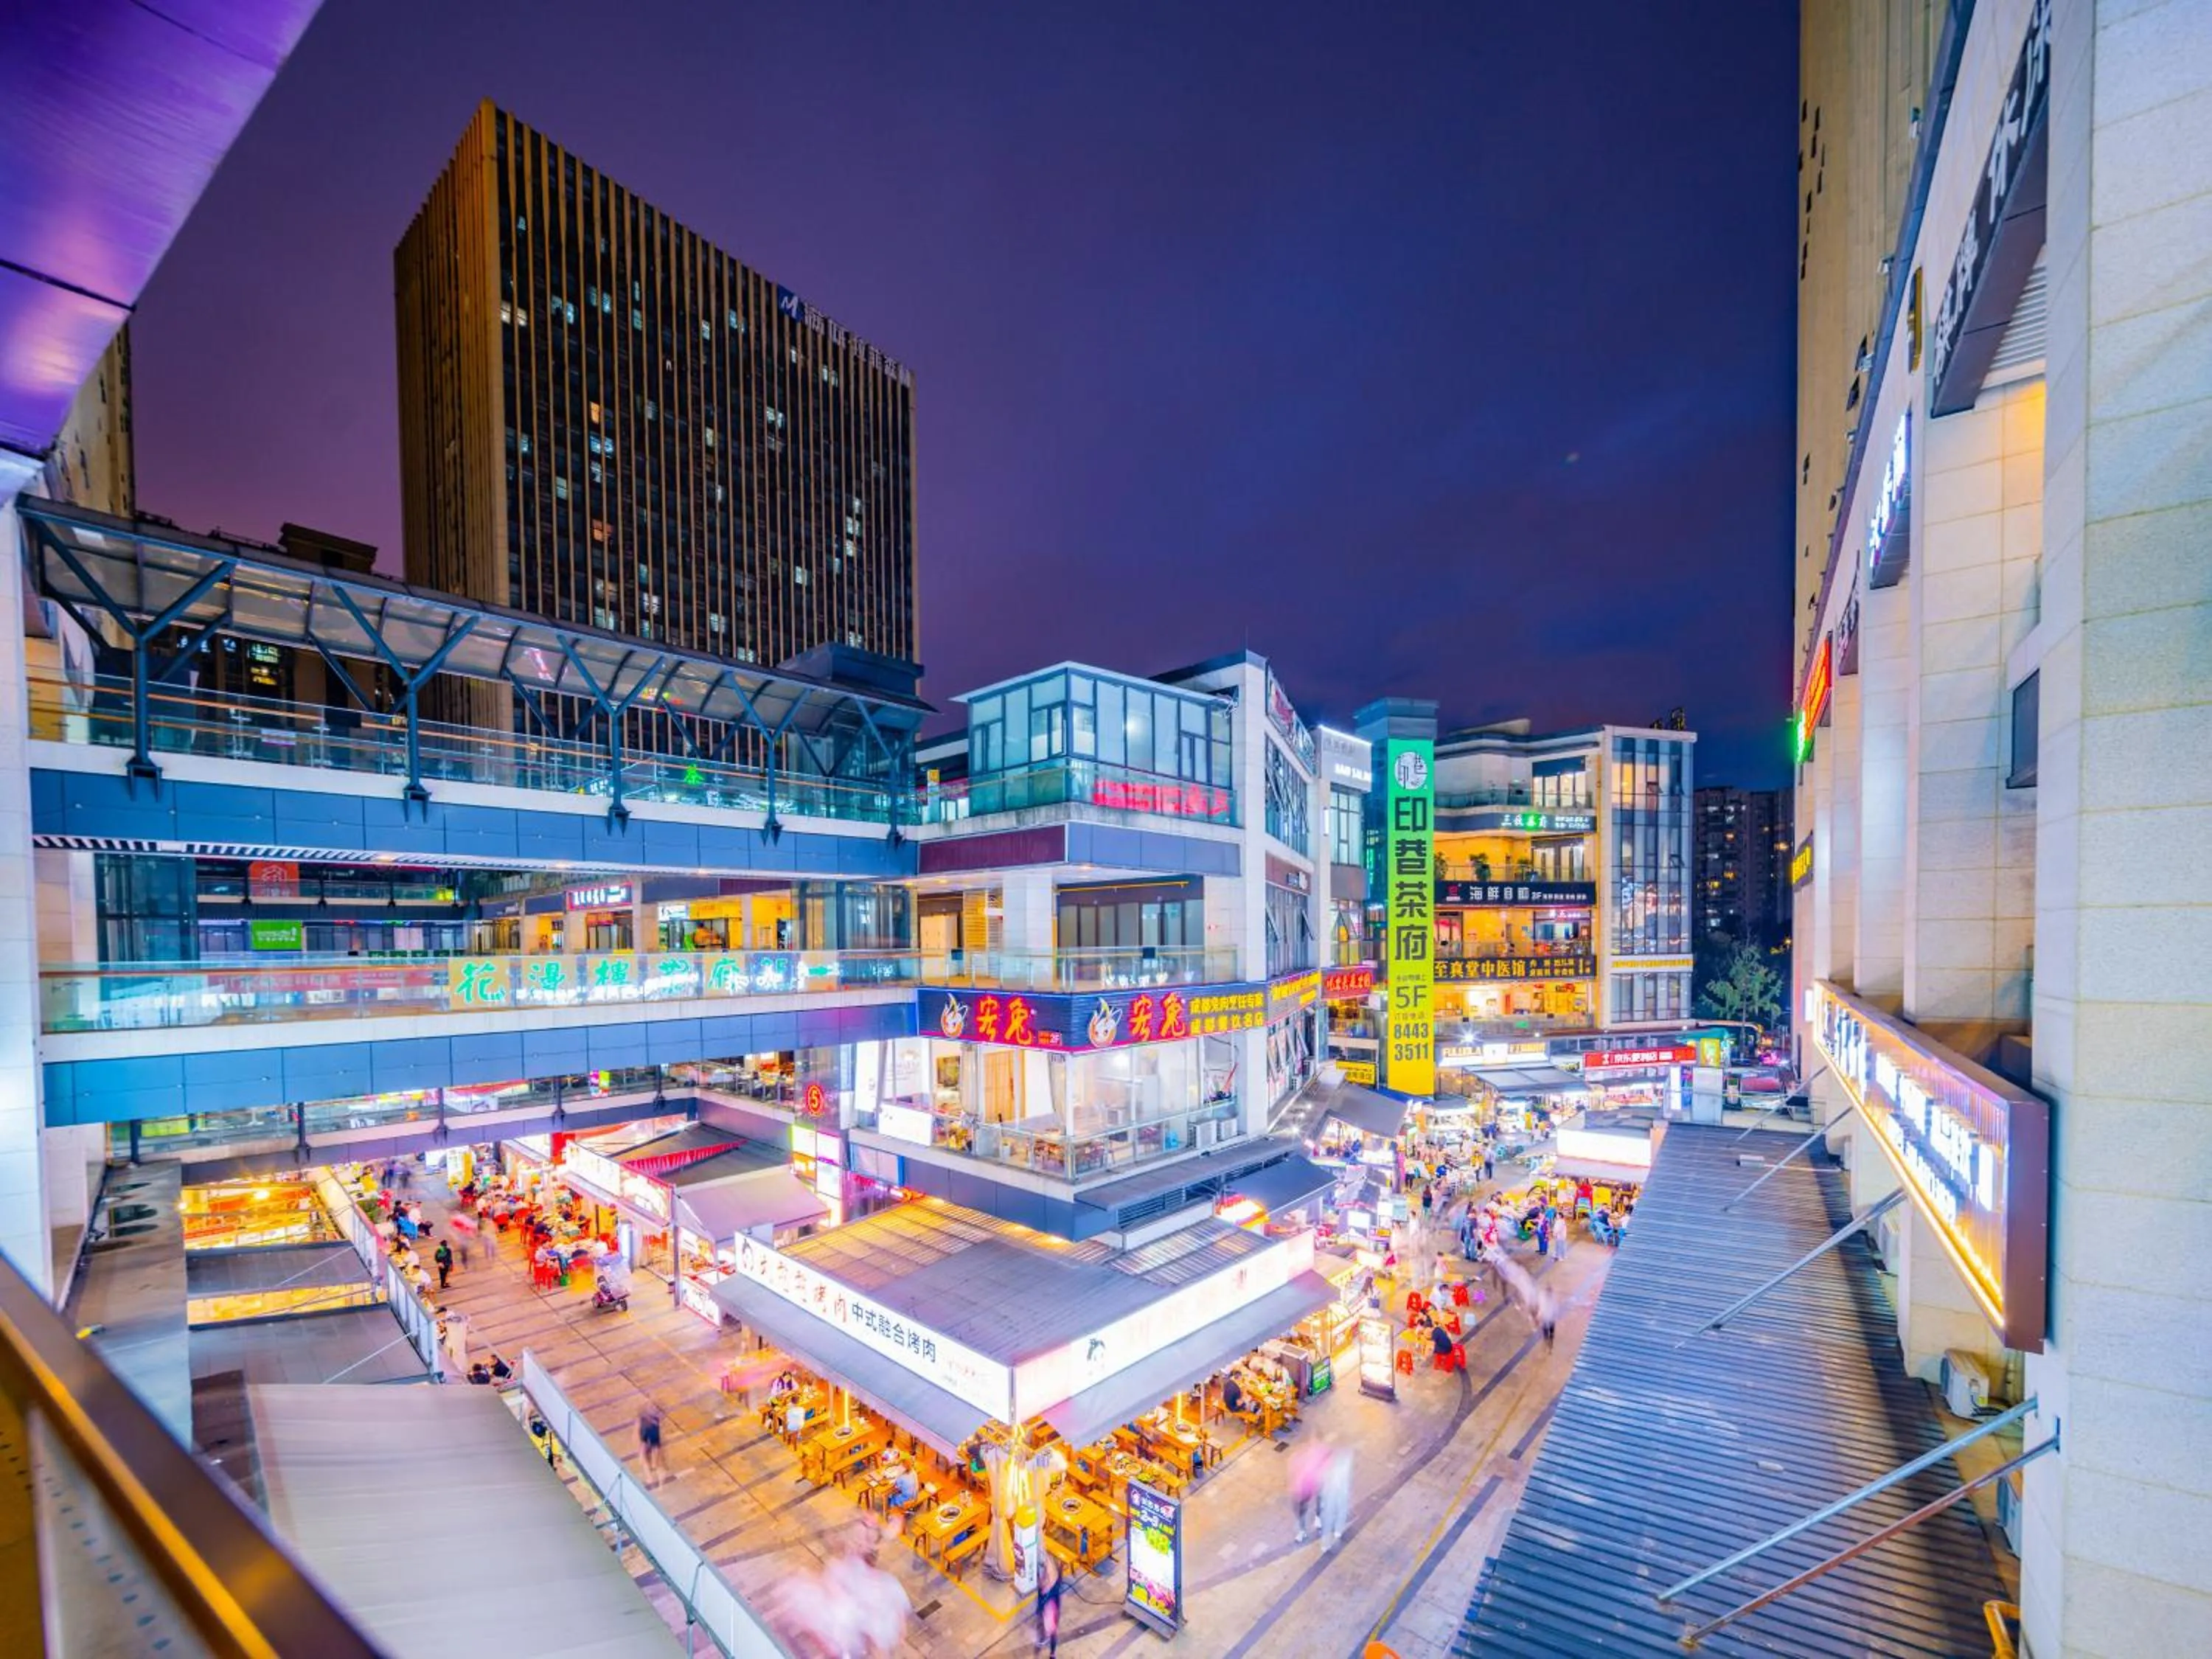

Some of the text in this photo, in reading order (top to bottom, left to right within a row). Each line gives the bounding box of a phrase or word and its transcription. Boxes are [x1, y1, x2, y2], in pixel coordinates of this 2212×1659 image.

[1434, 959, 1526, 978] 至真堂中医馆
[1395, 985, 1427, 1009] 5F
[1394, 1023, 1428, 1040] 8443
[1394, 1043, 1428, 1061] 3511
[852, 1302, 936, 1363] 中式融合烤肉
